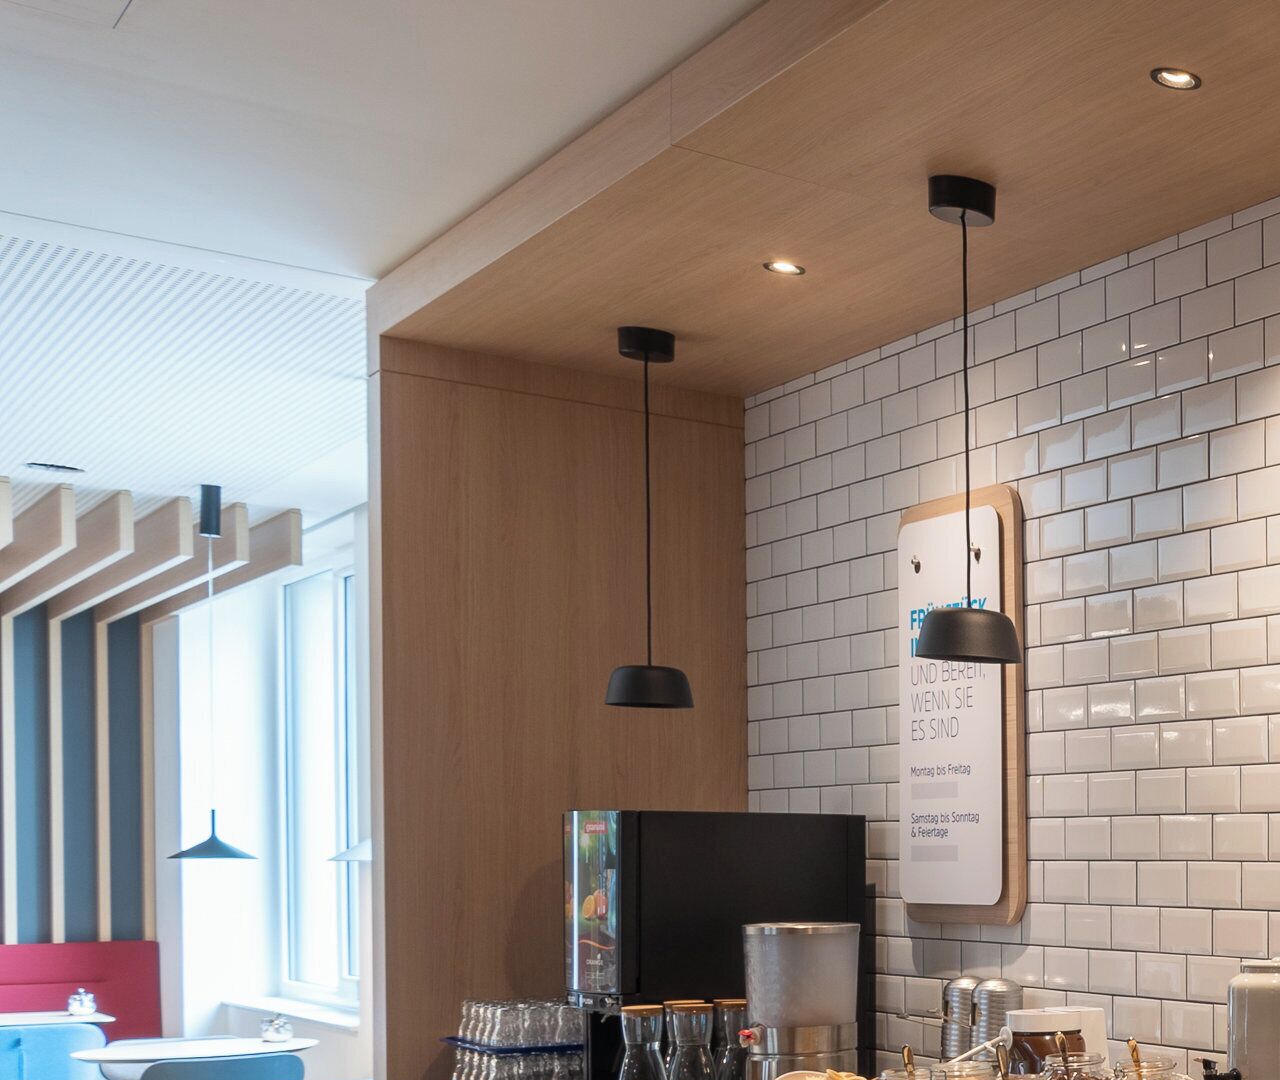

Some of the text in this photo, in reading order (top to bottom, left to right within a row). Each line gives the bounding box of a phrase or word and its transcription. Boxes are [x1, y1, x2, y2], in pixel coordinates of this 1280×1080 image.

[910, 662, 938, 686] UND
[910, 685, 974, 713] WENN SIE
[911, 715, 960, 742] ES SIND
[910, 763, 972, 778] Montag bis Freitag
[910, 811, 981, 825] Samstag bis Sonntag
[910, 826, 949, 839] & Feiertage
